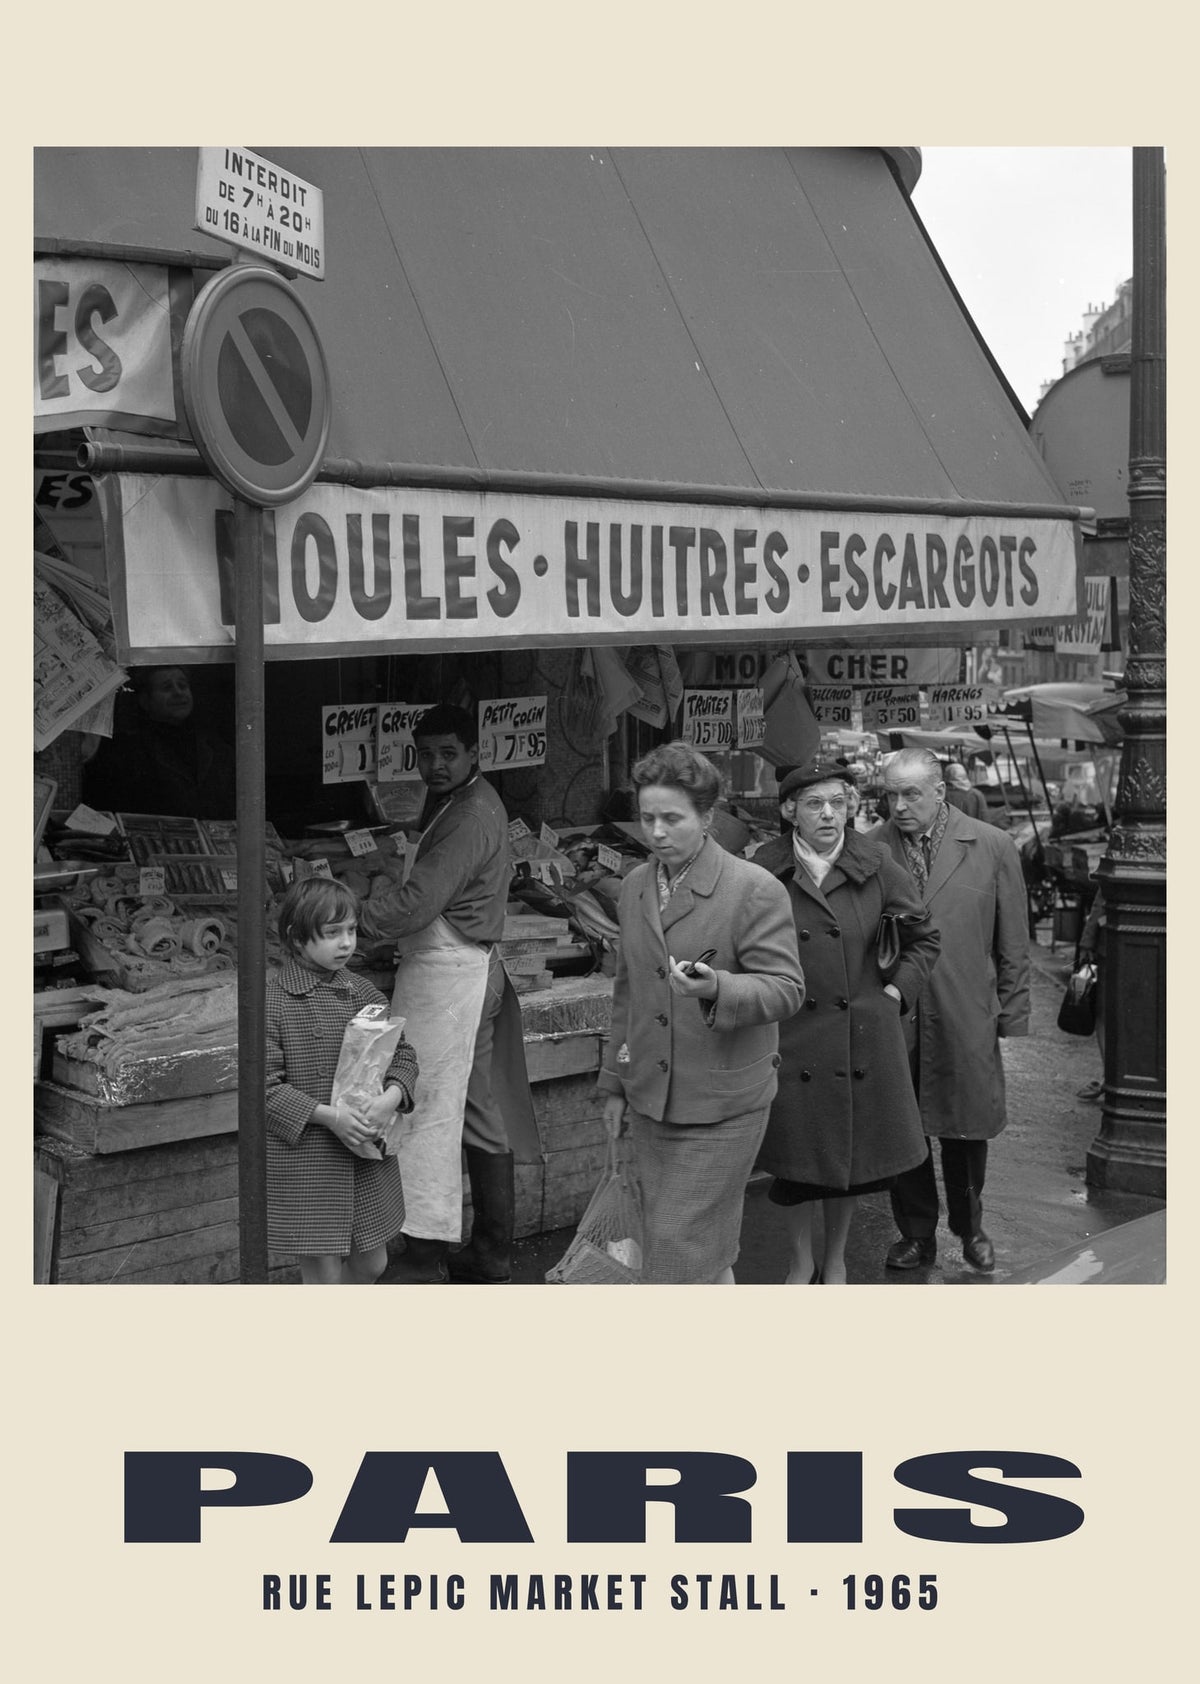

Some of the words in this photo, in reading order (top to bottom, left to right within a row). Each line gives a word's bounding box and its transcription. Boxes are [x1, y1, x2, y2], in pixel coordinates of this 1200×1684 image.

[219, 180, 235, 203] DE
[225, 148, 307, 207] INTERDIT
[205, 206, 219, 226] DU
[223, 208, 239, 234] 16
[251, 226, 260, 243] LA
[263, 225, 281, 252] FIN
[283, 240, 293, 257] DU
[296, 240, 320, 268] MOIS
[38, 279, 123, 400] ES
[36, 473, 93, 509] ES
[564, 520, 791, 618] HUITRES
[820, 531, 1039, 613] ESCARGOTS
[827, 654, 909, 680] CHER
[932, 688, 983, 704] HARENGS
